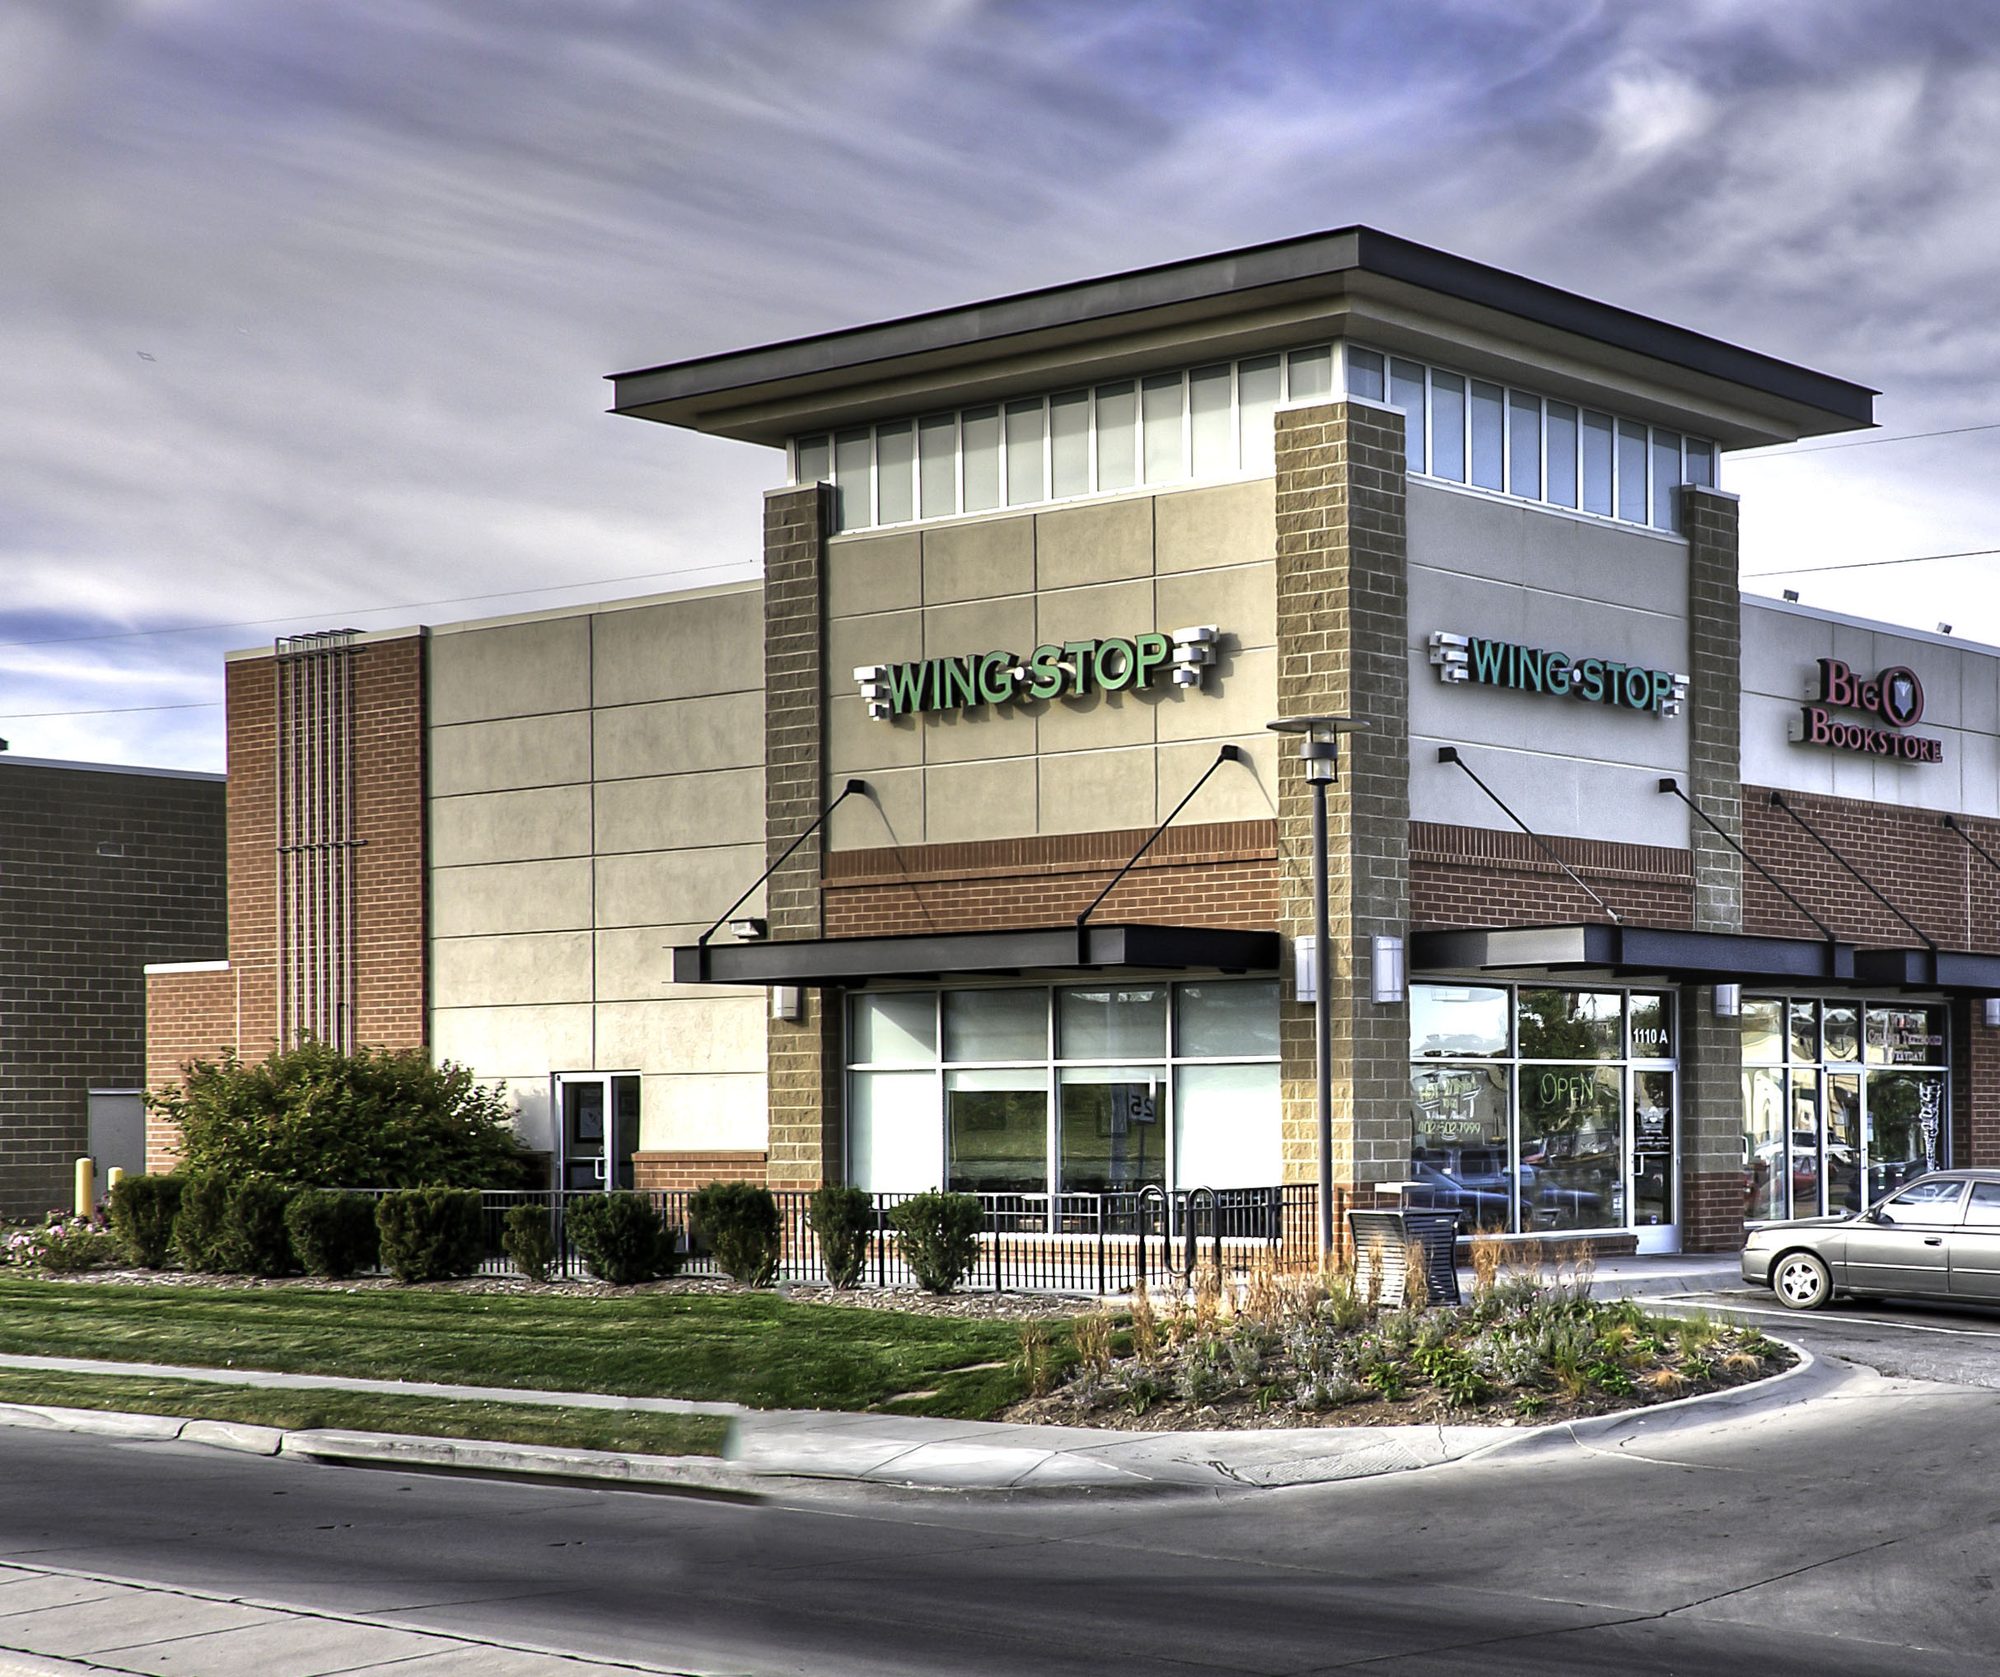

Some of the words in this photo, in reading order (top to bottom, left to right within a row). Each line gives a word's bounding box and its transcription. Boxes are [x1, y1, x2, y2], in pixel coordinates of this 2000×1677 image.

[1807, 707, 1942, 763] BOOKSTORE
[1633, 1028, 1657, 1044] 1110
[1659, 1028, 1669, 1044] A
[1541, 1073, 1593, 1105] OPEN
